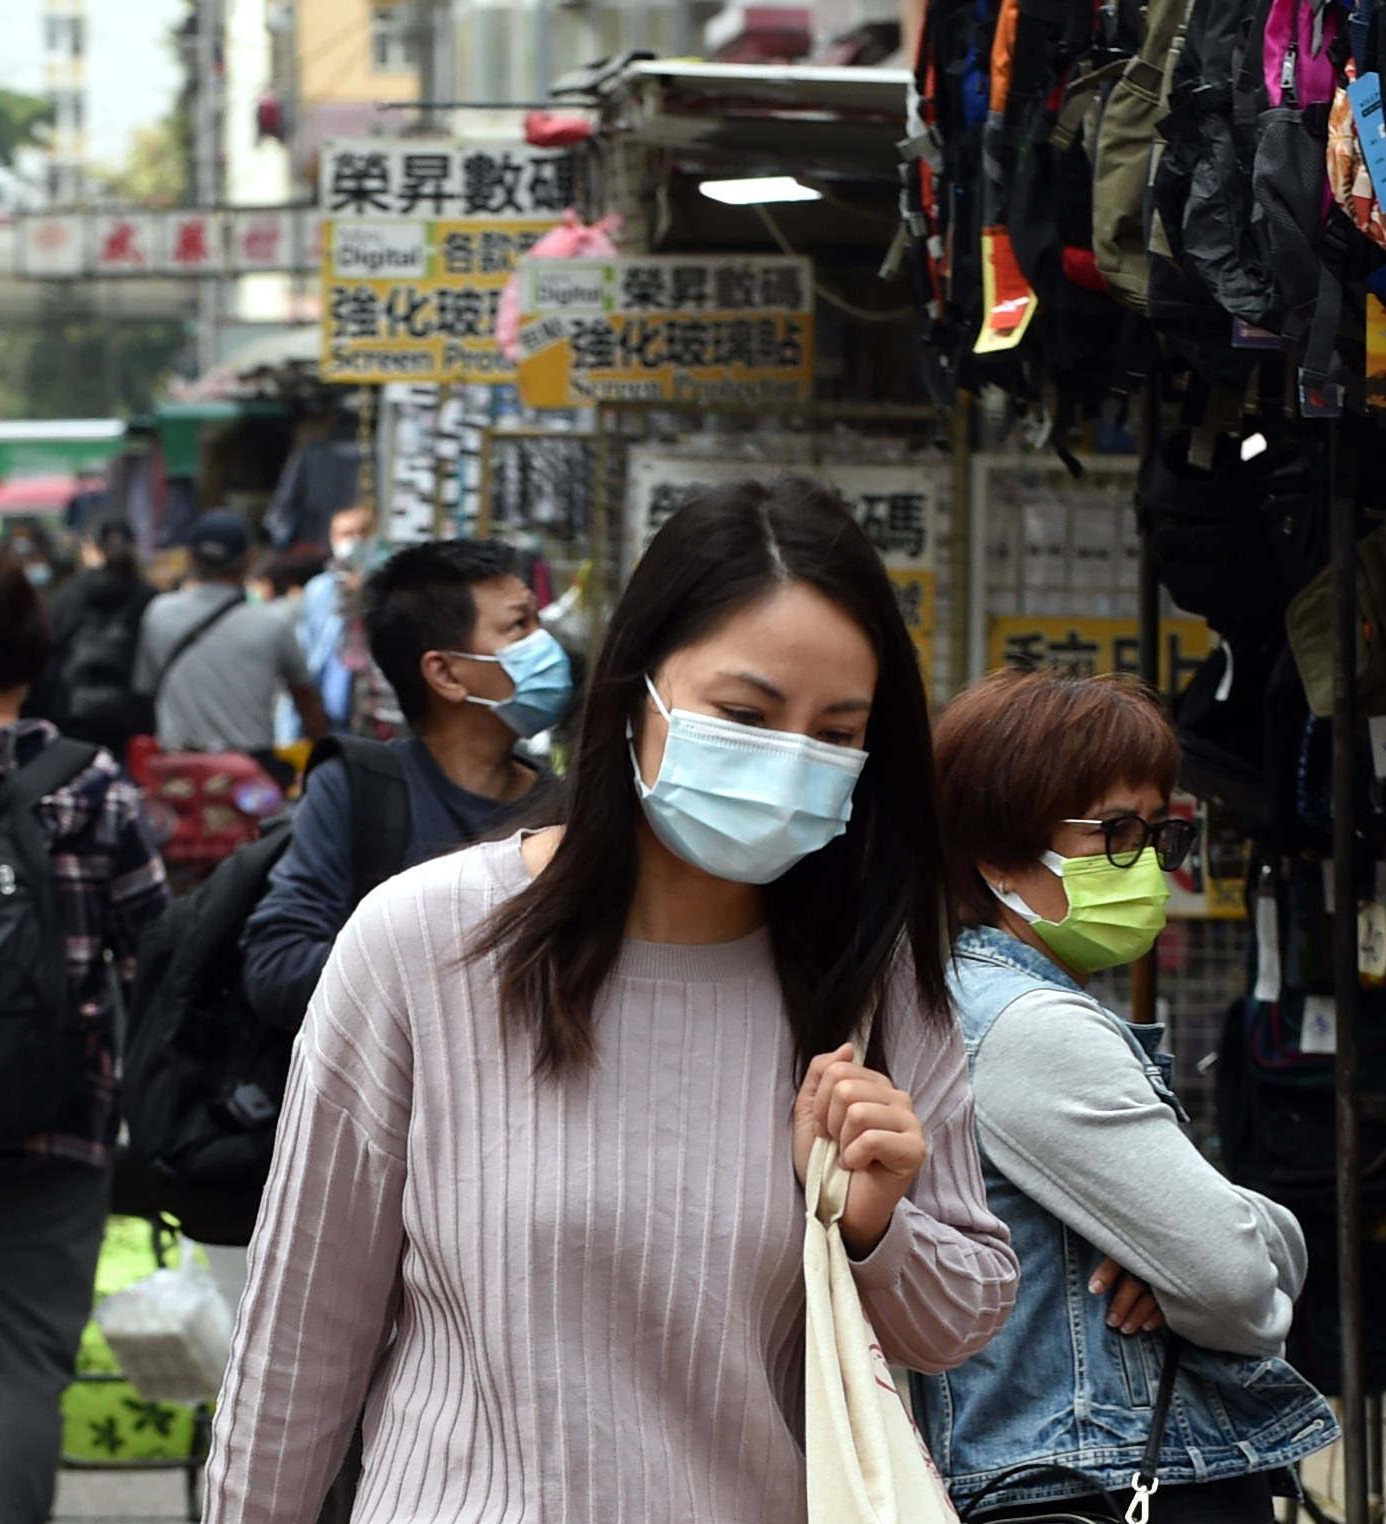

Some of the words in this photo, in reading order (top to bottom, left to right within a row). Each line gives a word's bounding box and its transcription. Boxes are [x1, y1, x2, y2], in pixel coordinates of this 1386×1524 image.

[336, 247, 417, 271] Digital
[536, 285, 602, 304] Digital
[330, 285, 500, 338] 強化玻
[569, 318, 802, 368] 強化玻璃貼
[332, 345, 434, 372] Screen
